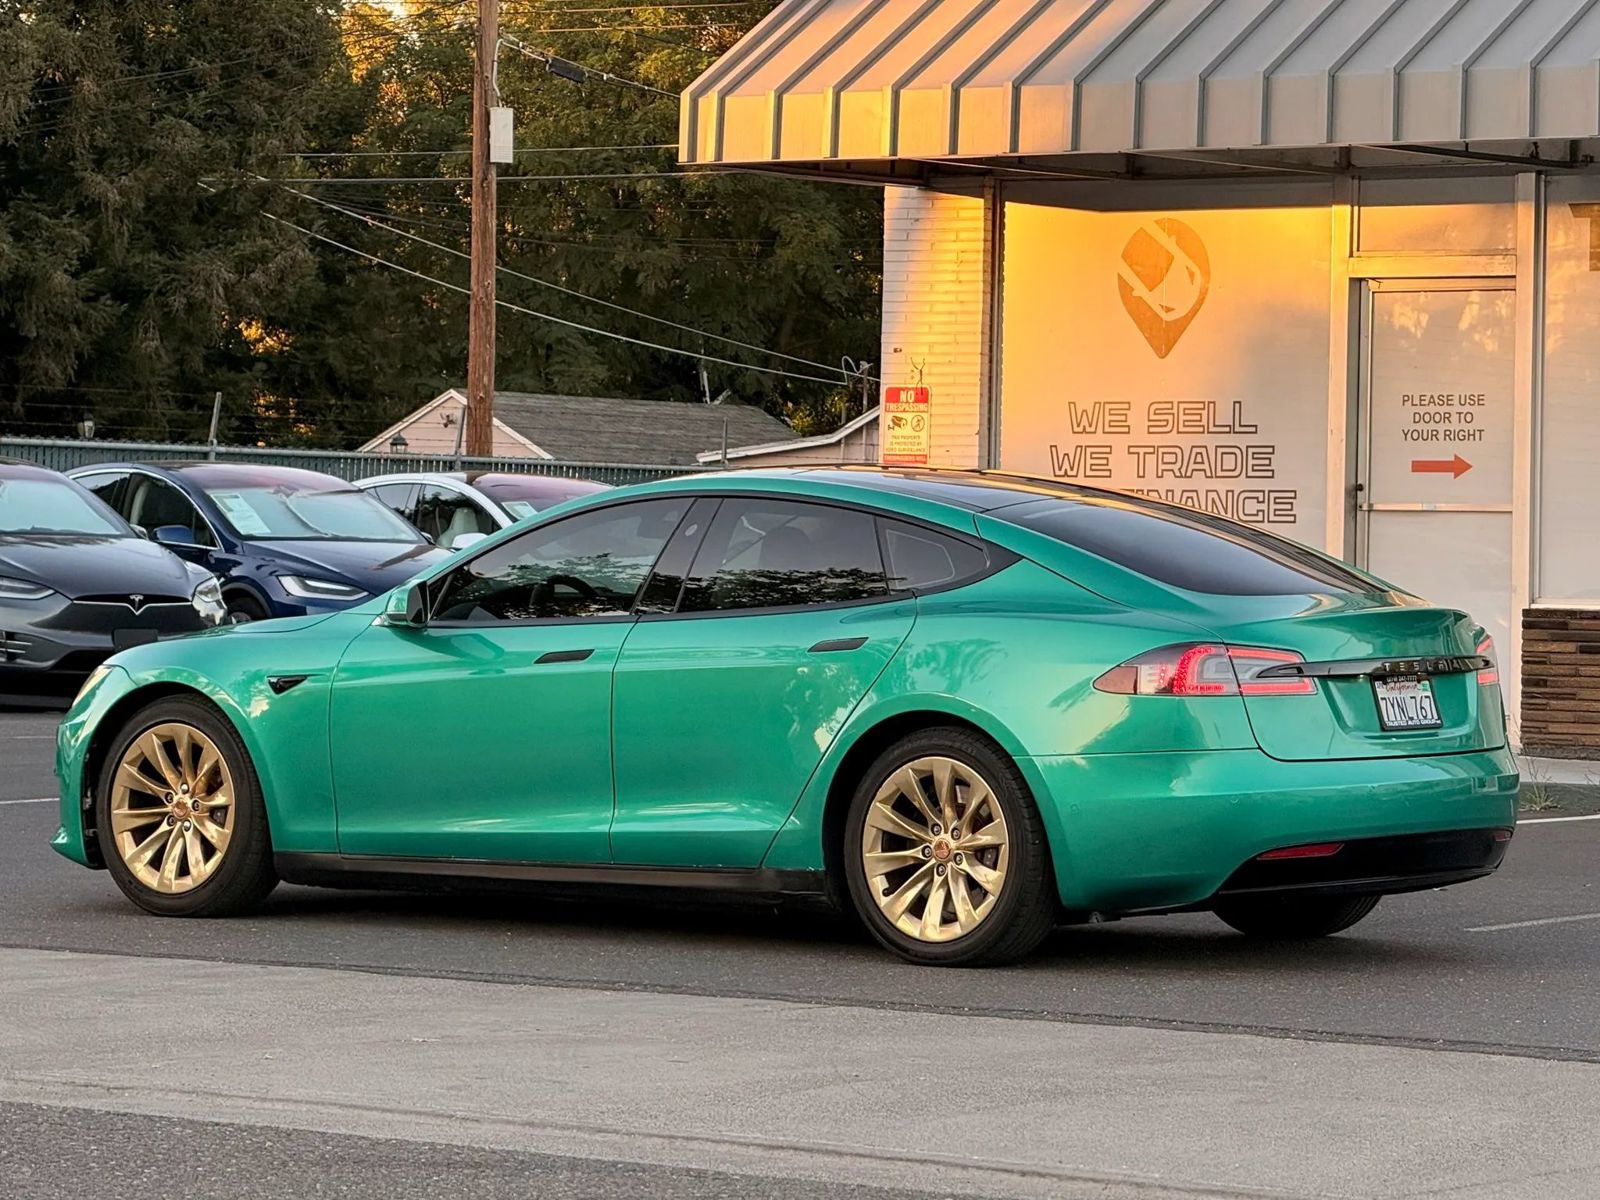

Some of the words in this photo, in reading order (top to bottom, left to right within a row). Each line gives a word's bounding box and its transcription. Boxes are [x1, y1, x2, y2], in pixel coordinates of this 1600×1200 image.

[900, 390, 914, 402] NO
[1402, 394, 1454, 406] PLEASE
[1458, 394, 1485, 406] USE
[1068, 401, 1131, 434] WE
[1147, 401, 1258, 434] SELL
[1413, 411, 1452, 424] DOOR
[1456, 411, 1474, 424] TO
[1402, 429, 1440, 441] YOUR
[1443, 429, 1485, 441] RIGHT
[1049, 445, 1112, 478] WE
[1128, 445, 1275, 479] TRADE
[1380, 695, 1434, 721] 7YNL767
